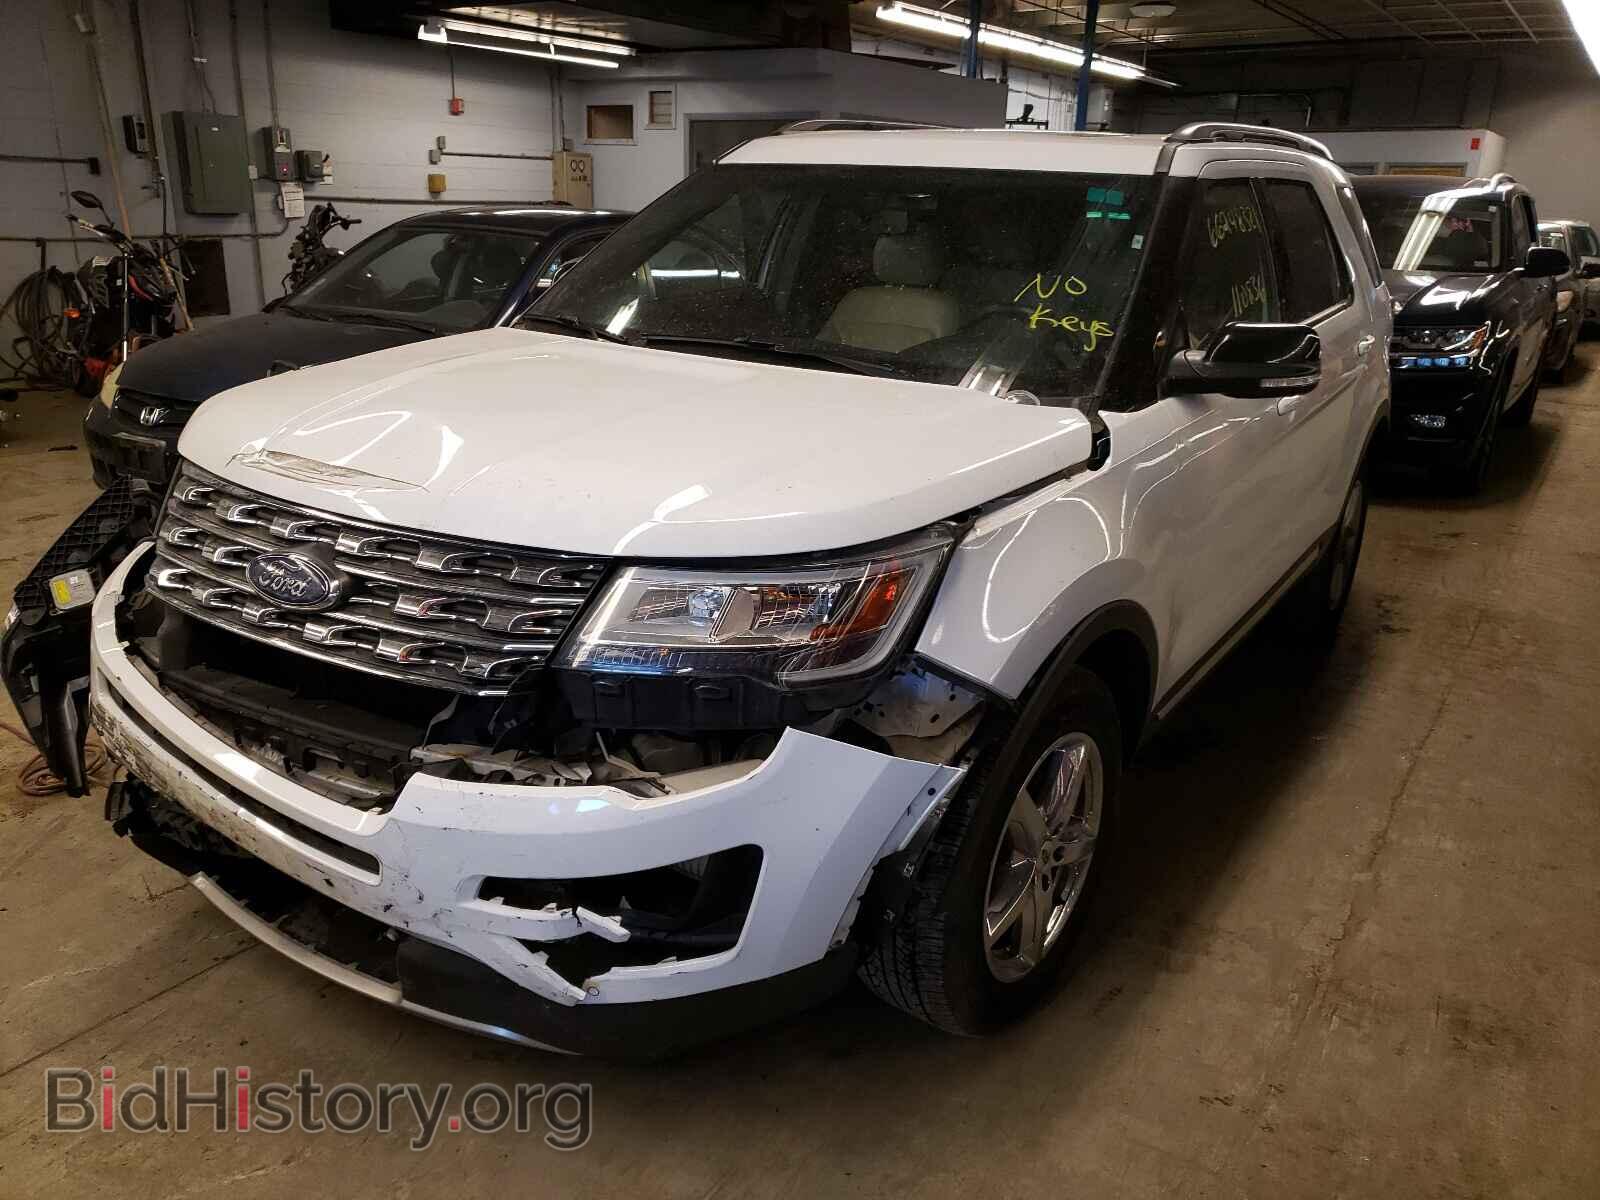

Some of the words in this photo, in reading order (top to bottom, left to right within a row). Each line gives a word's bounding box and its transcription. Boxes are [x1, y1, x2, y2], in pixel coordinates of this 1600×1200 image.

[1013, 272, 1088, 302] NO
[1029, 302, 1115, 352] Keys
[255, 560, 312, 597] Ford
